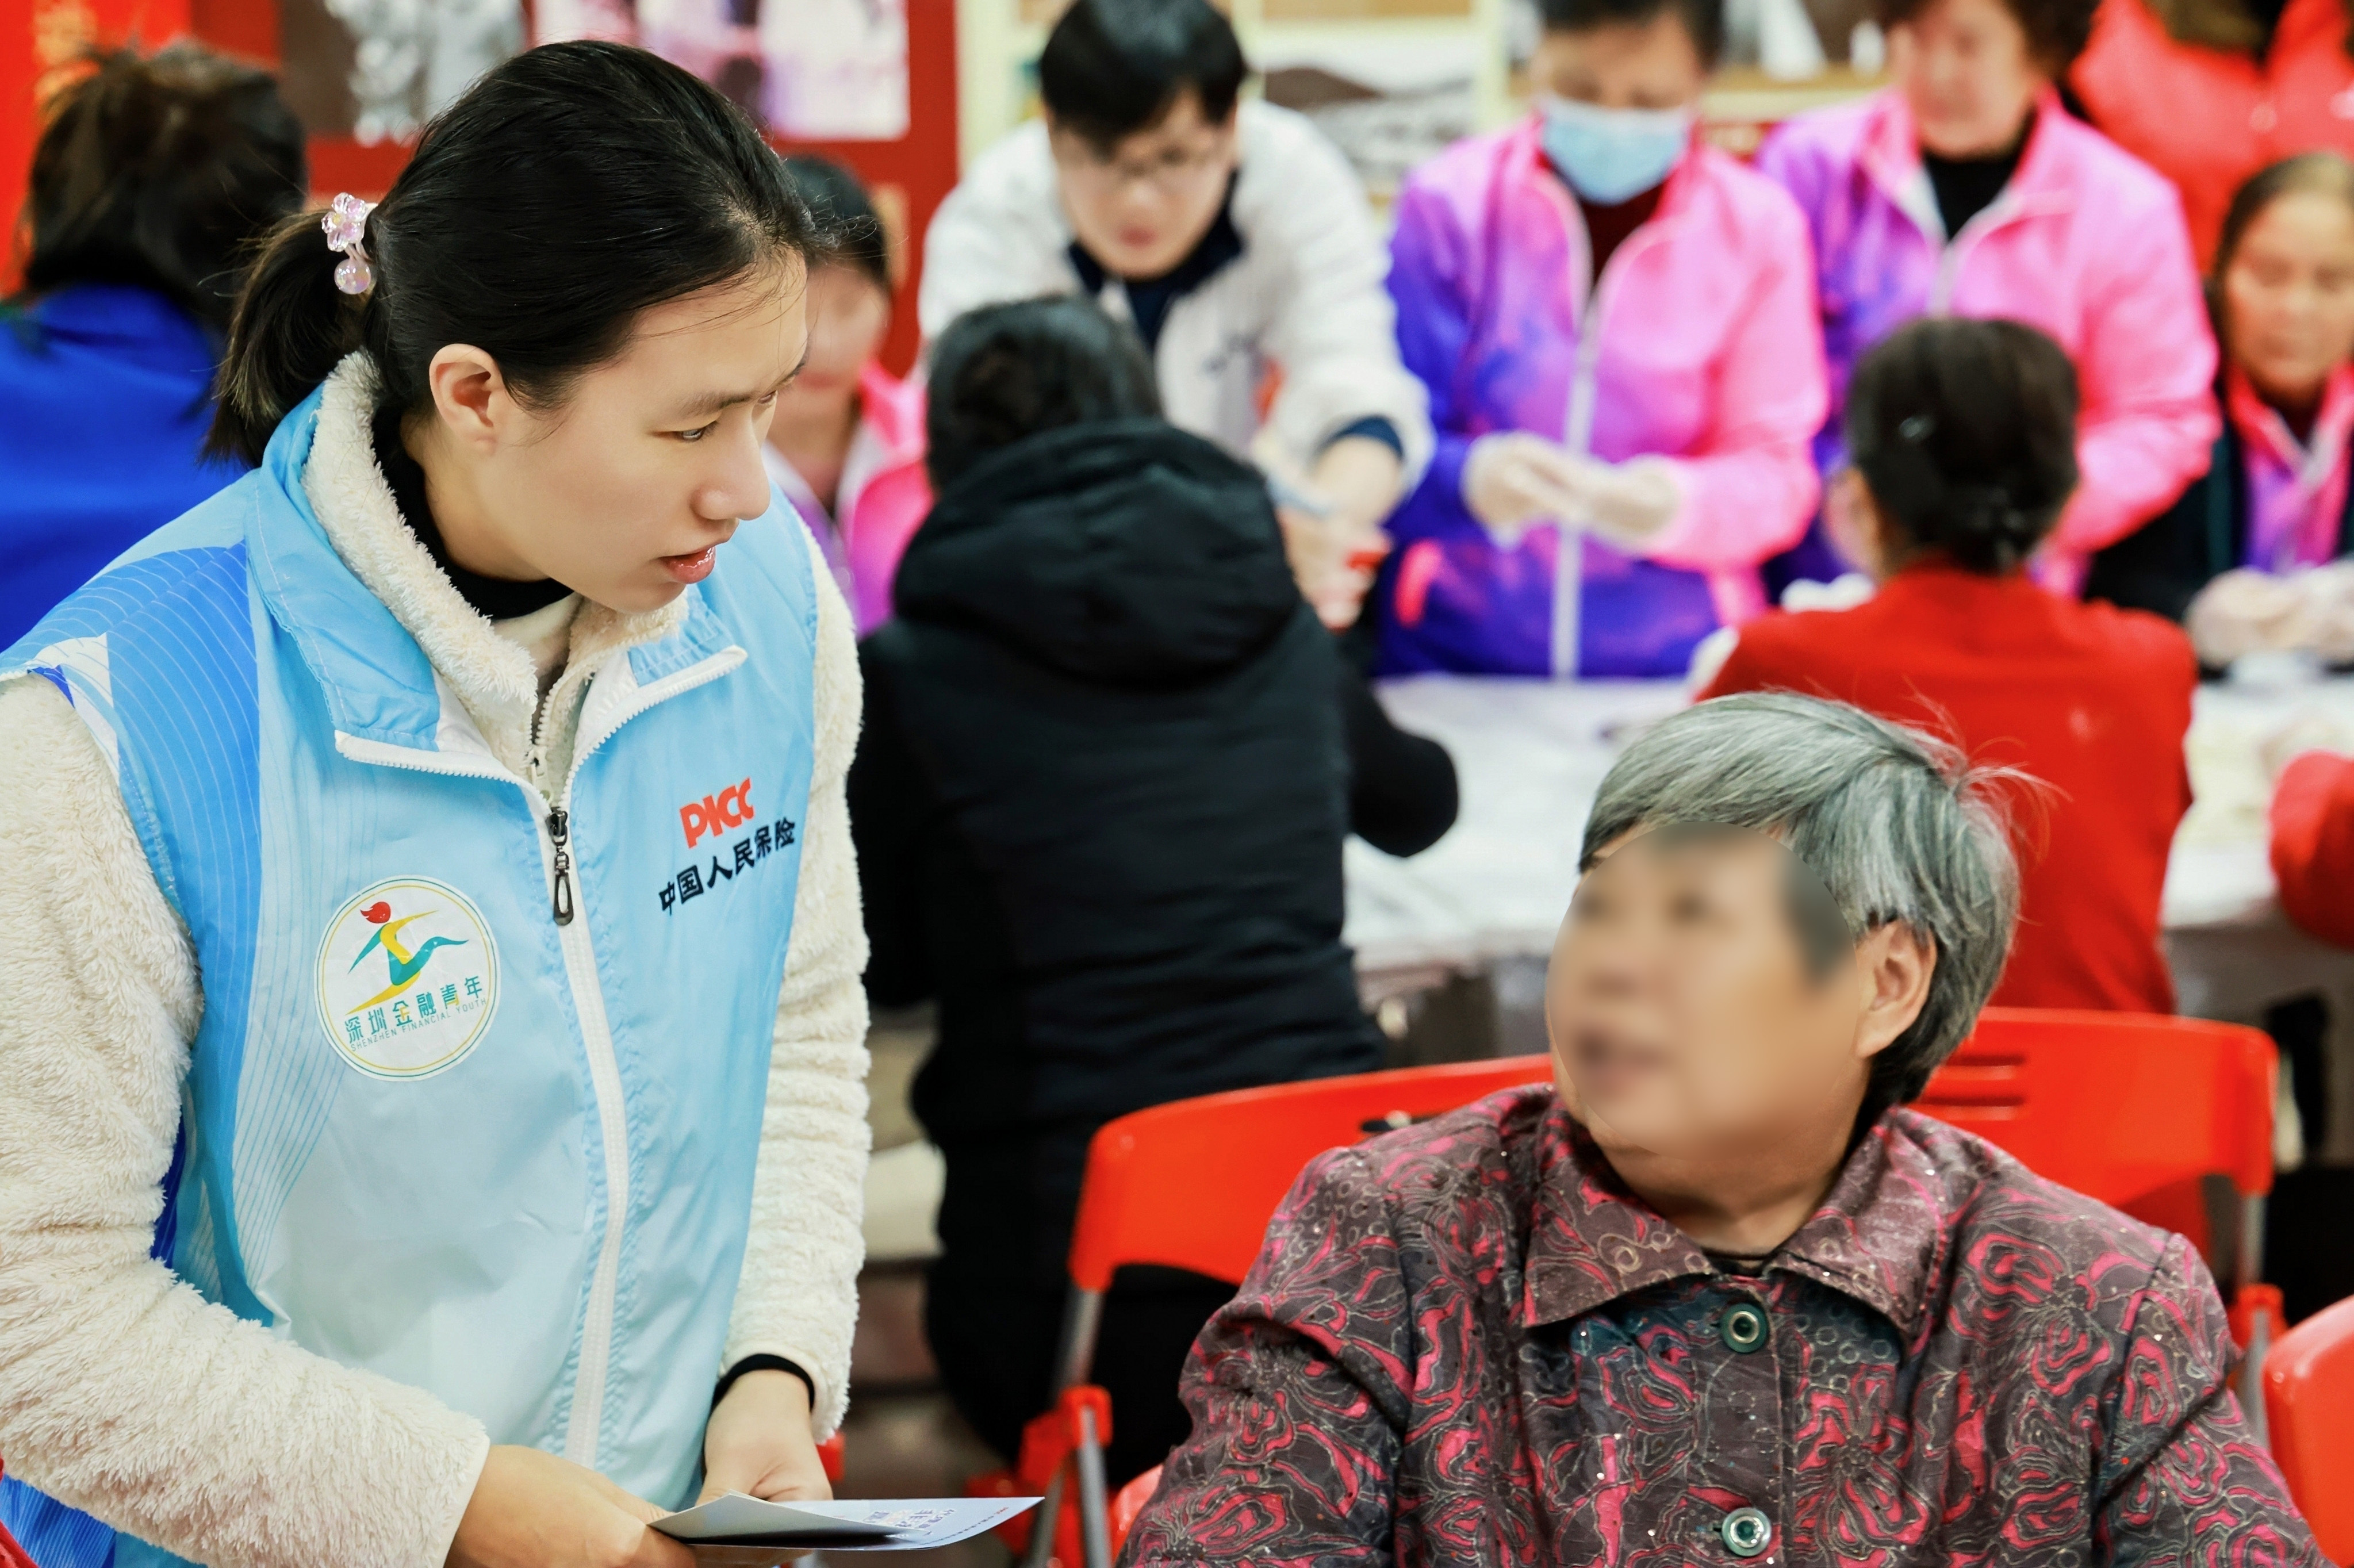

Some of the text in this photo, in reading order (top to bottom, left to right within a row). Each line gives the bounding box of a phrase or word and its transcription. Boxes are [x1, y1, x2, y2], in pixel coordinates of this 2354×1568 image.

[680, 778, 754, 848] PICC
[659, 817, 795, 915] 中国人民保险
[345, 976, 482, 1043] 深圳金融青年
[351, 998, 487, 1052] SHENZHEN FINANCIAL YOUTH
